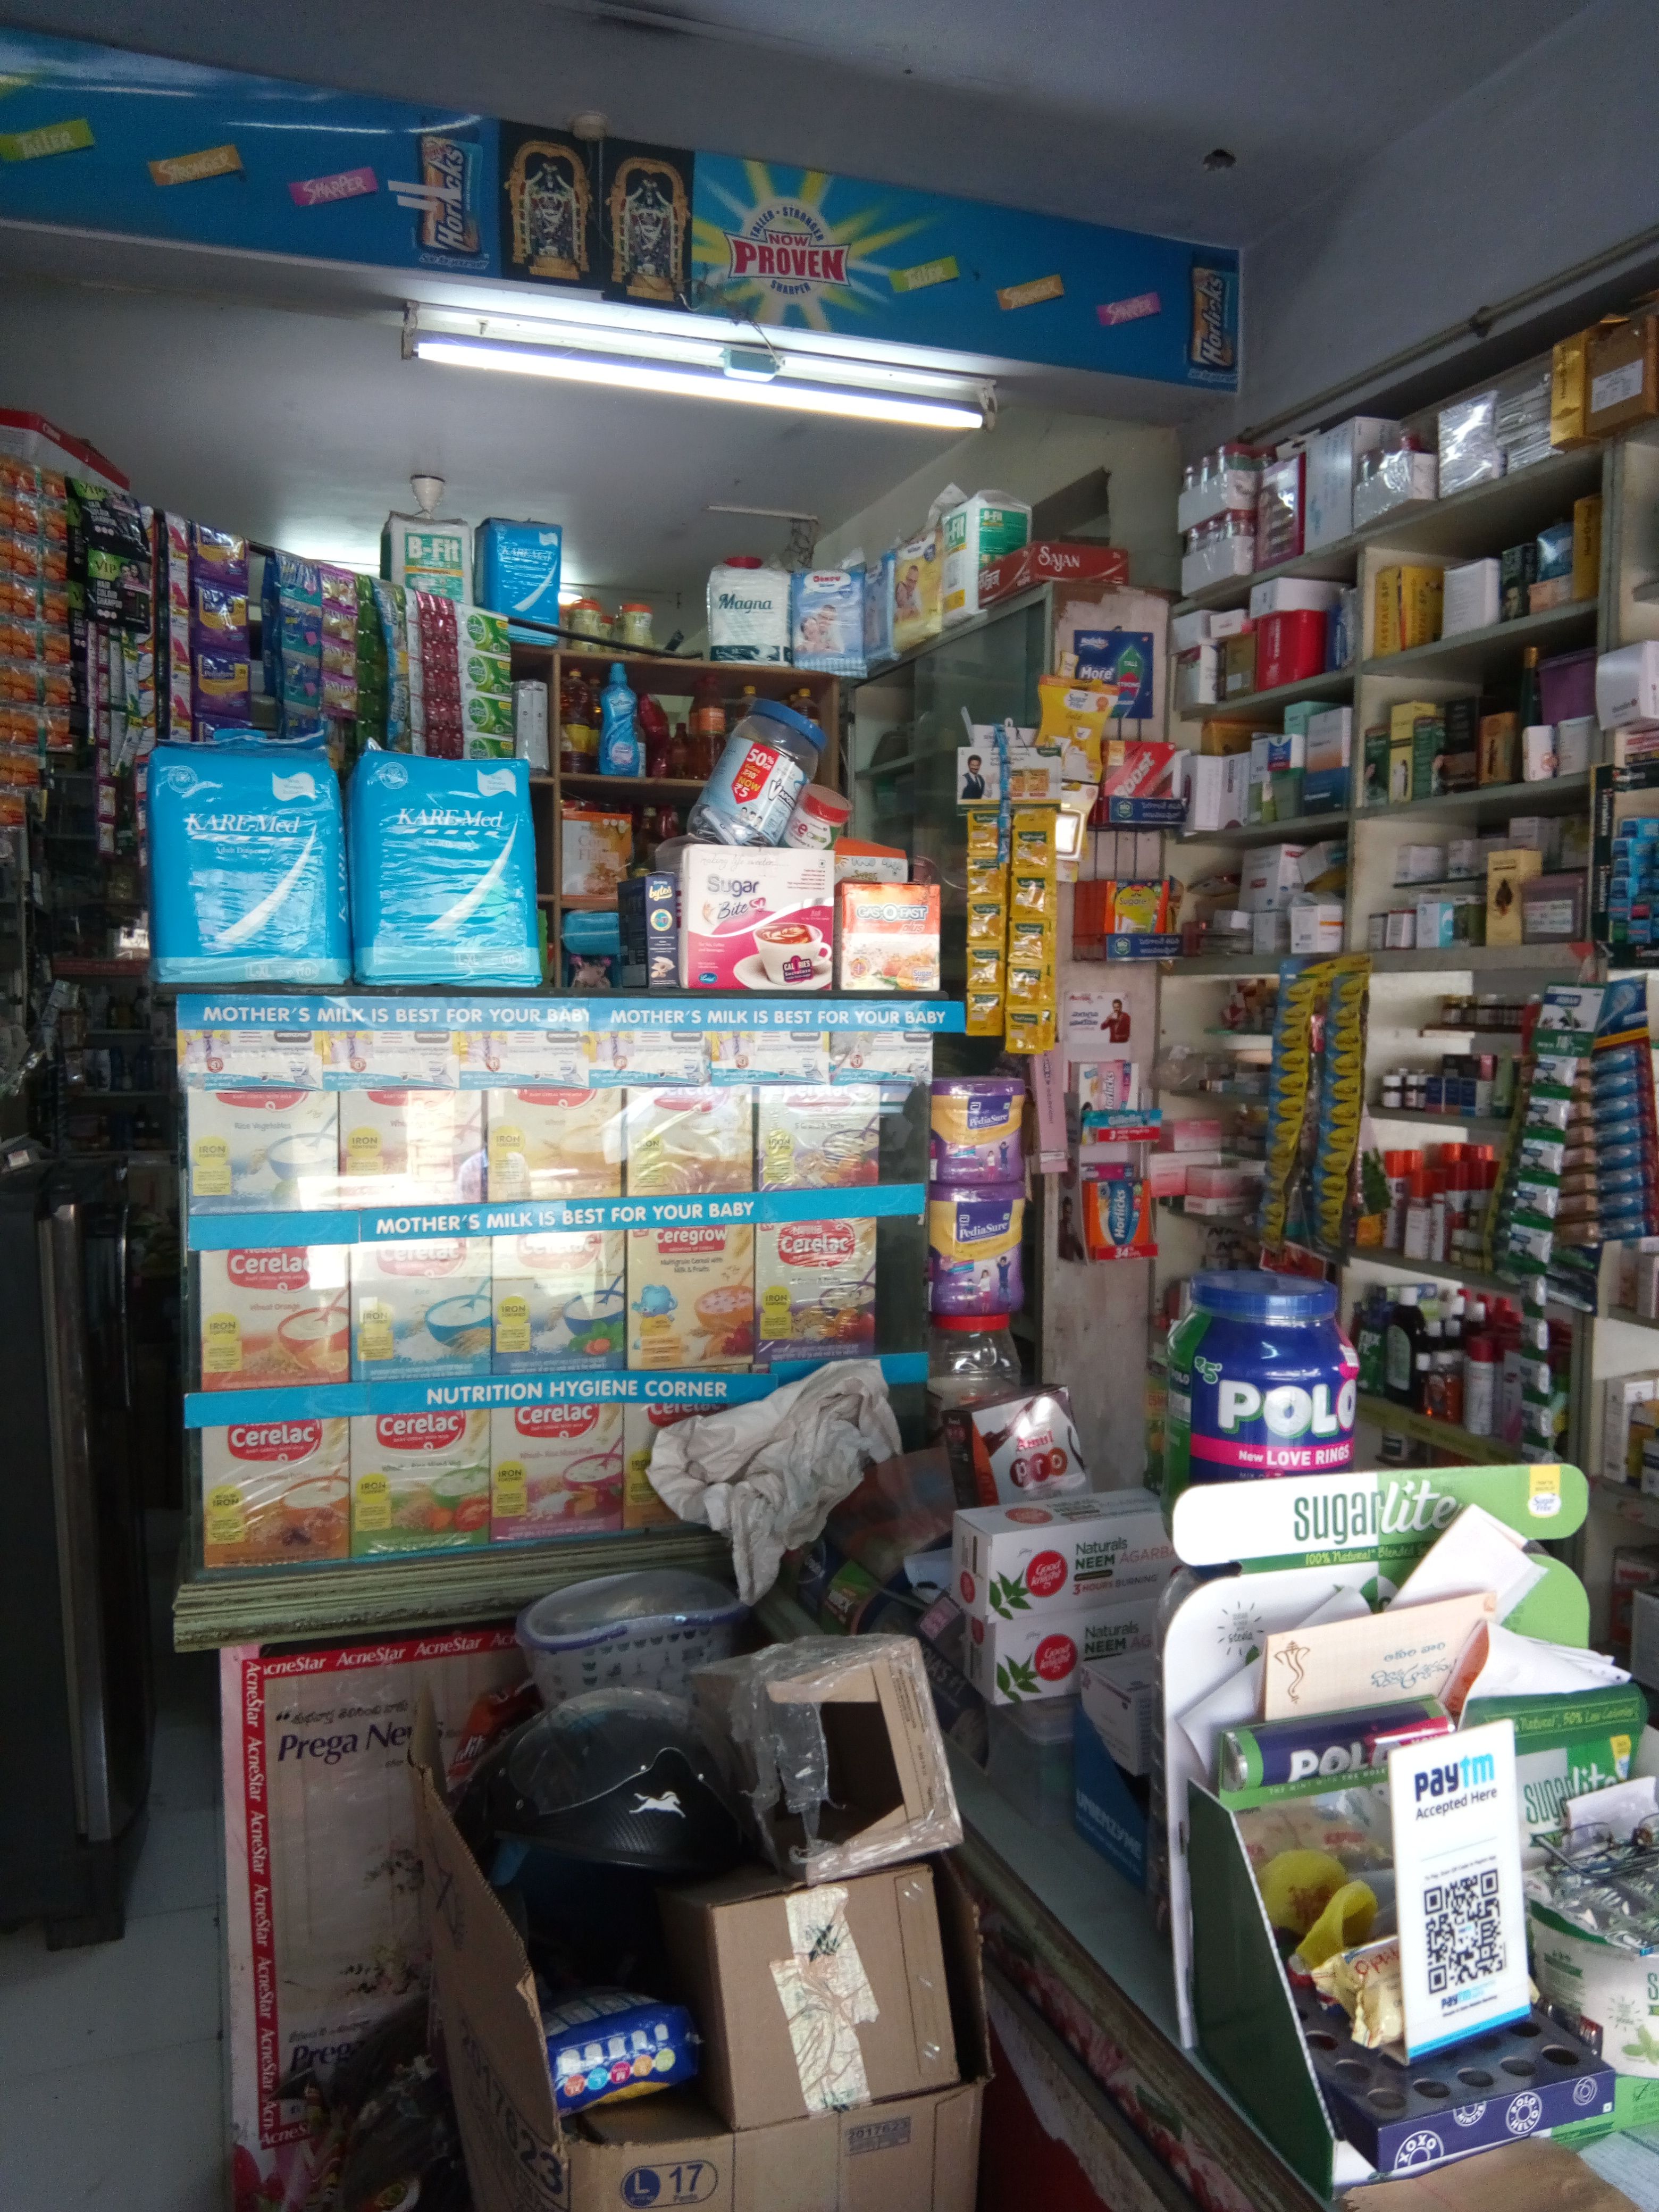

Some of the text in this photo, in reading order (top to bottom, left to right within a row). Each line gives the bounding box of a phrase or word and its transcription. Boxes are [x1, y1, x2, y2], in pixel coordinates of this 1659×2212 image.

[783, 206, 824, 241] STRONGER
[768, 234, 809, 246] NOW
[734, 239, 845, 281] PROVEN
[407, 536, 460, 562] B-Fit
[718, 593, 774, 614] Magna
[738, 776, 761, 791] NOW
[187, 813, 300, 833] KARE-Med
[397, 808, 504, 828] KARE-Med
[707, 875, 759, 897] Sugar
[718, 901, 749, 919] Bite
[203, 1006, 310, 1022] MOTHER'S
[317, 1008, 364, 1023] MILK
[373, 1008, 389, 1023] IS
[396, 1008, 438, 1023] BEST
[447, 1008, 482, 1023] FOR
[489, 1009, 541, 1023] YOUR
[610, 1009, 945, 1024] MOTHER'S MILK IS BEST FOR YOUR BABY
[969, 1114, 1008, 1127] PediaSure
[352, 1136, 378, 1145] IRON
[376, 1201, 755, 1234] MOTHER'S MILK IS BEST FOR YOUR BABY
[1115, 1190, 1127, 1238] Horlicks
[655, 1226, 728, 1245] Ceregrow
[959, 1222, 1008, 1239] PediaSure
[780, 1234, 849, 1254] Cerelac
[363, 1311, 388, 1320] IRON
[427, 1380, 727, 1405] NUTRITION HYGIENE CORNER
[517, 1405, 592, 1425] Cerelac
[1219, 1379, 1356, 1435] POLO
[379, 1413, 459, 1435] Cerelac
[231, 1426, 315, 1447] Cerelac
[1239, 1445, 1350, 1467] New LOVE RINGS
[498, 1469, 522, 1477] IRON
[1015, 1454, 1063, 1484] pro
[213, 1498, 239, 1507] IRON
[1075, 1536, 1127, 1556] Naturals
[1036, 1560, 1062, 1574] Good
[1075, 1554, 1115, 1570] NEEM
[1305, 1552, 1331, 1566] 100%
[1073, 1583, 1080, 1595] 3
[1082, 1580, 1113, 1591] HOURS
[1085, 1620, 1139, 1639] Naturals
[336, 1646, 407, 1668] AcneStar
[414, 1635, 483, 1657] AcneStar
[1084, 1638, 1127, 1653] NEEM
[245, 1661, 264, 1728] AcneStar
[278, 1733, 358, 1765] Prega
[247, 1736, 264, 1802] AcneStar
[1270, 1786, 1285, 1795] THE
[1342, 1772, 1359, 1781] THE
[1415, 1788, 1497, 1821] Accepted Here
[249, 1809, 266, 1876] AcneStar
[253, 1883, 269, 1948] AcneStar
[256, 1954, 272, 2020] AcneStar
[261, 2026, 278, 2093] AcneStar
[1512, 2095, 1536, 2114] POLO
[1512, 2109, 1538, 2131] HELLO
[262, 2121, 311, 2148] AcneS
[1399, 2134, 1436, 2163] XOXO
[635, 2164, 703, 2195] L 17
